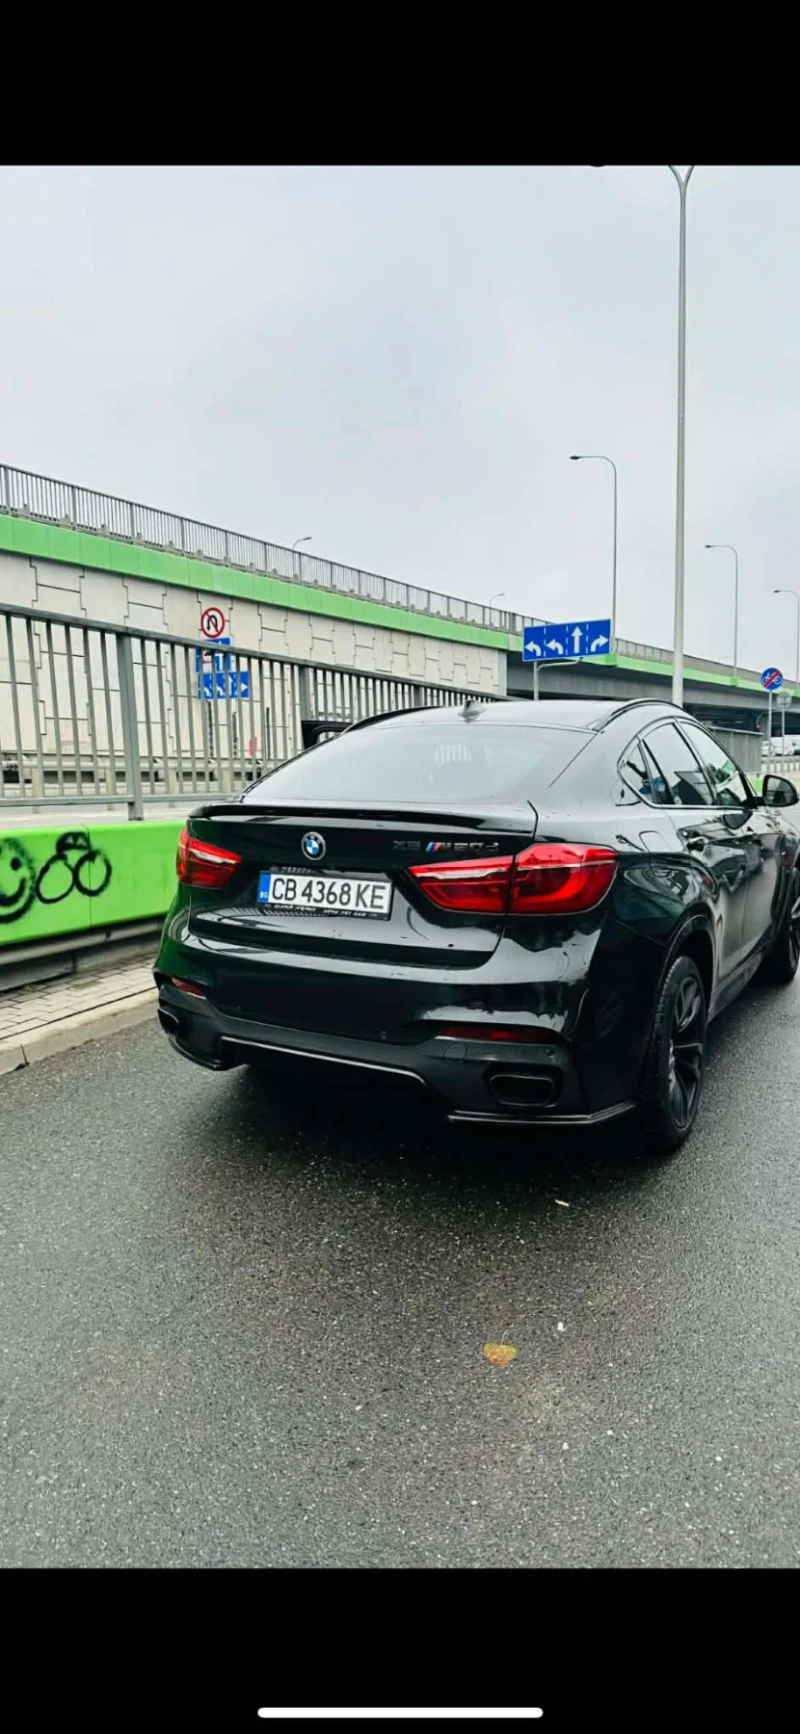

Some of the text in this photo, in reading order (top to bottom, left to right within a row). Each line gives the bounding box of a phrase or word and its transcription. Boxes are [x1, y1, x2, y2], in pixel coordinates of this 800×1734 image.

[272, 878, 386, 910] CB 4368 KE
